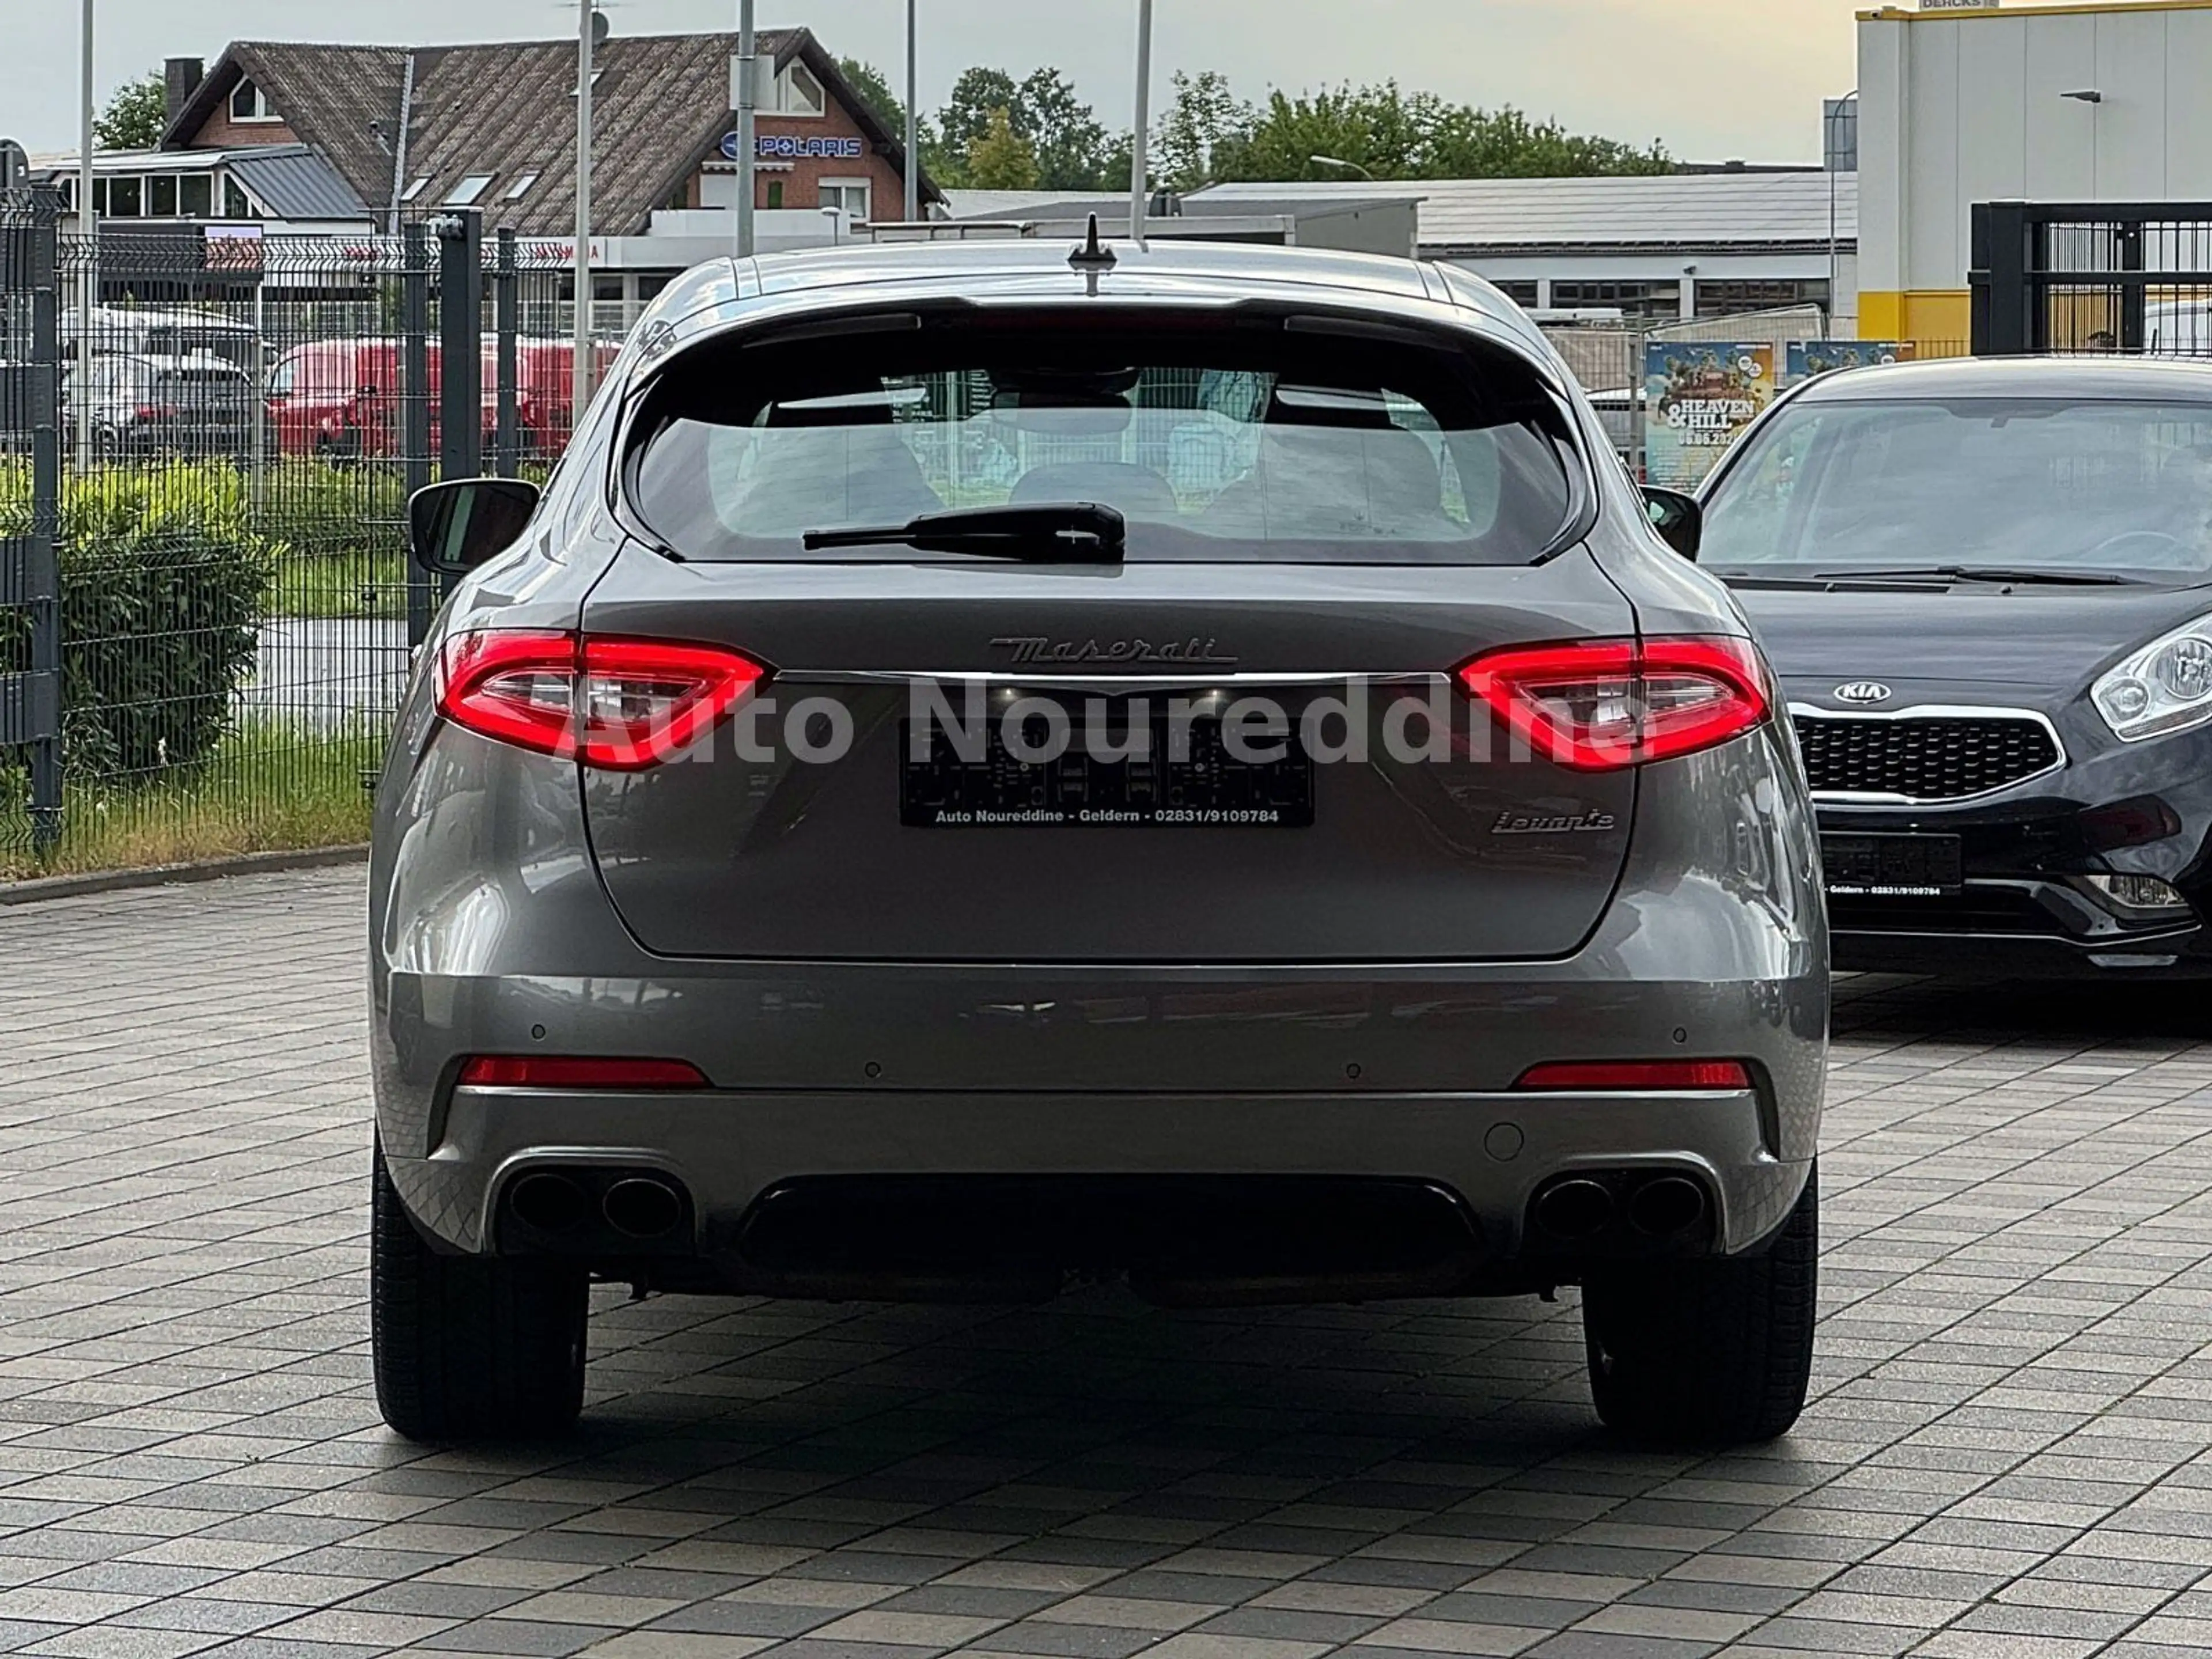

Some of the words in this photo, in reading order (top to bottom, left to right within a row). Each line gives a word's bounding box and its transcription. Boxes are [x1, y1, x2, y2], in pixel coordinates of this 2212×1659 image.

[760, 136, 862, 157] POLARIS
[1681, 399, 1755, 413] HEAVEN
[1667, 404, 1686, 429] &
[1688, 414, 1732, 429] HILL
[990, 637, 1238, 662] Maserati
[1843, 684, 1881, 698] KIA
[935, 810, 972, 823] Auto
[976, 809, 1064, 822] Noureddine
[1080, 809, 1140, 822] Geldern
[1155, 809, 1279, 823] 02831/9109784
[1491, 808, 1614, 833] Levante
[1830, 885, 1864, 894] Geldern
